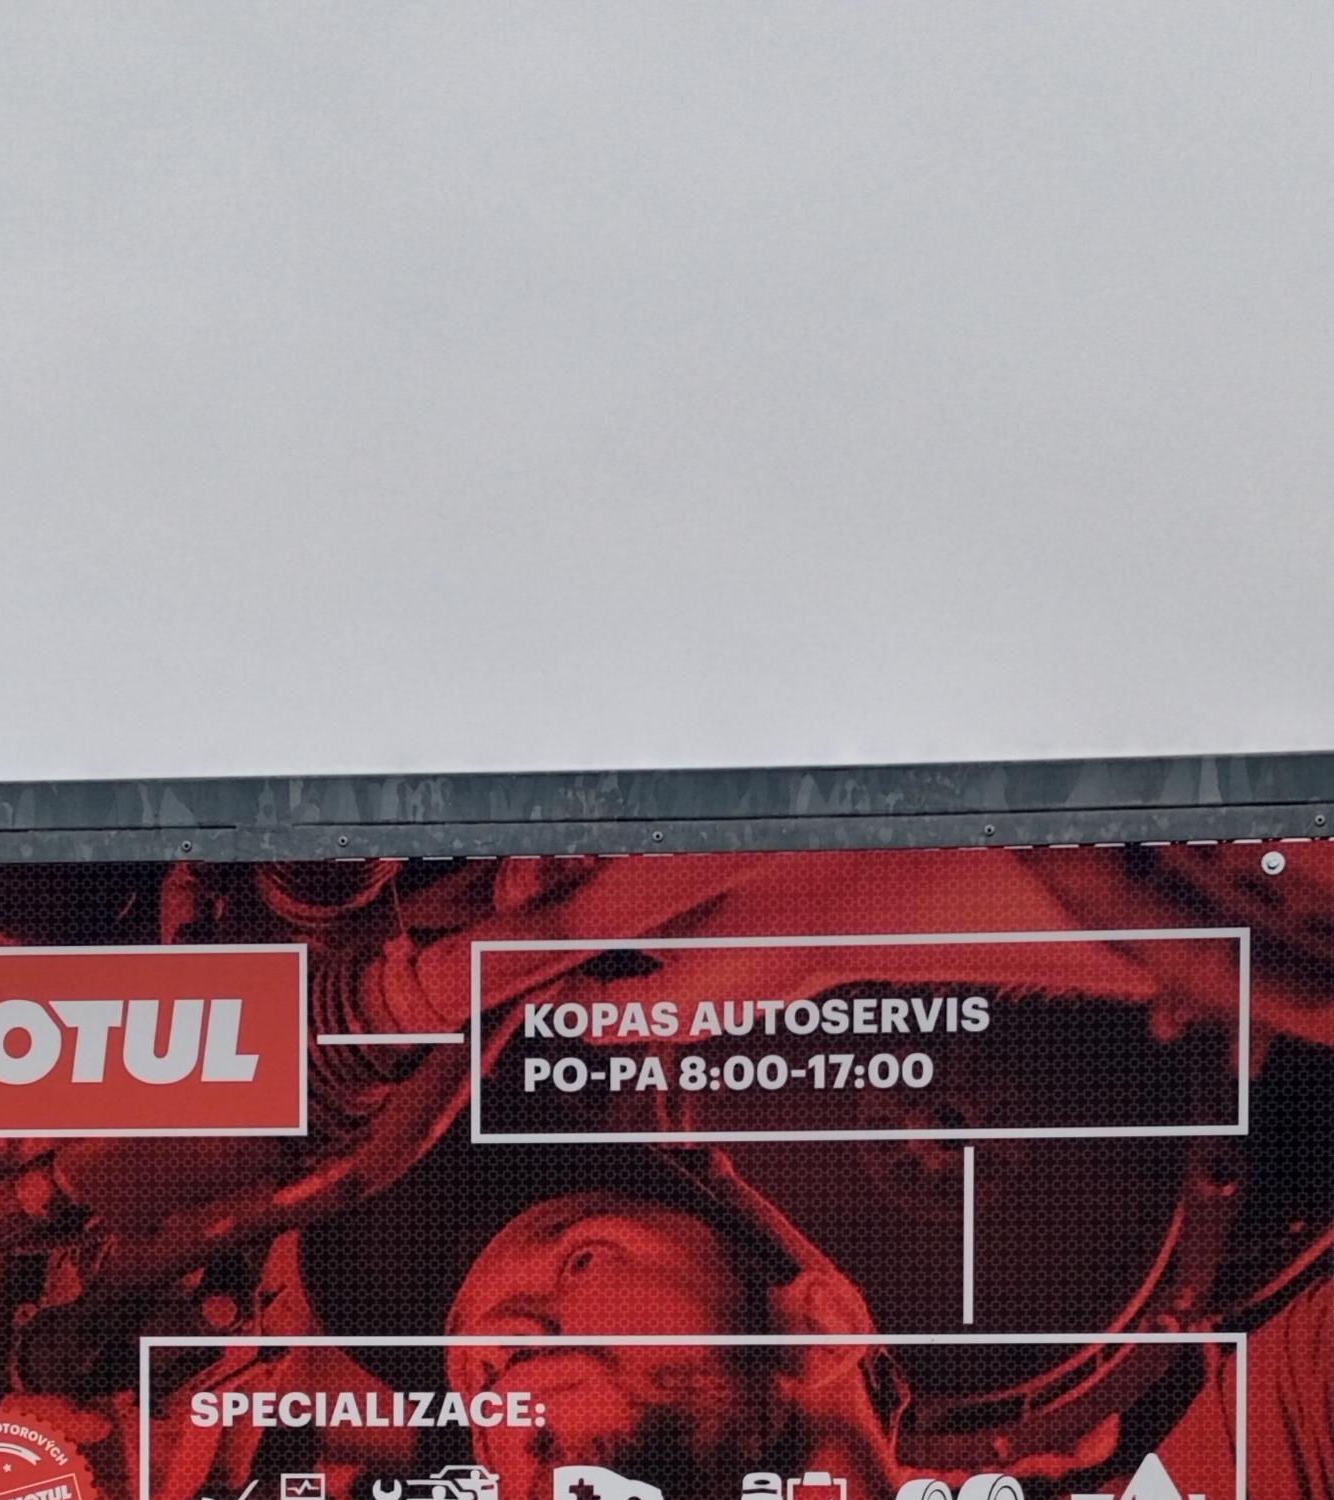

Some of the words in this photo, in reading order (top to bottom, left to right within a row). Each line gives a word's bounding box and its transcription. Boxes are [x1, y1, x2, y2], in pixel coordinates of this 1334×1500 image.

[523, 1000, 678, 1040] KOPAS
[689, 996, 991, 1038] AUTOSERVIS
[523, 1054, 669, 1094] PO-PA
[678, 1051, 935, 1091] 8:00-17:00
[189, 1391, 547, 1428] SPECIALIZACE:
